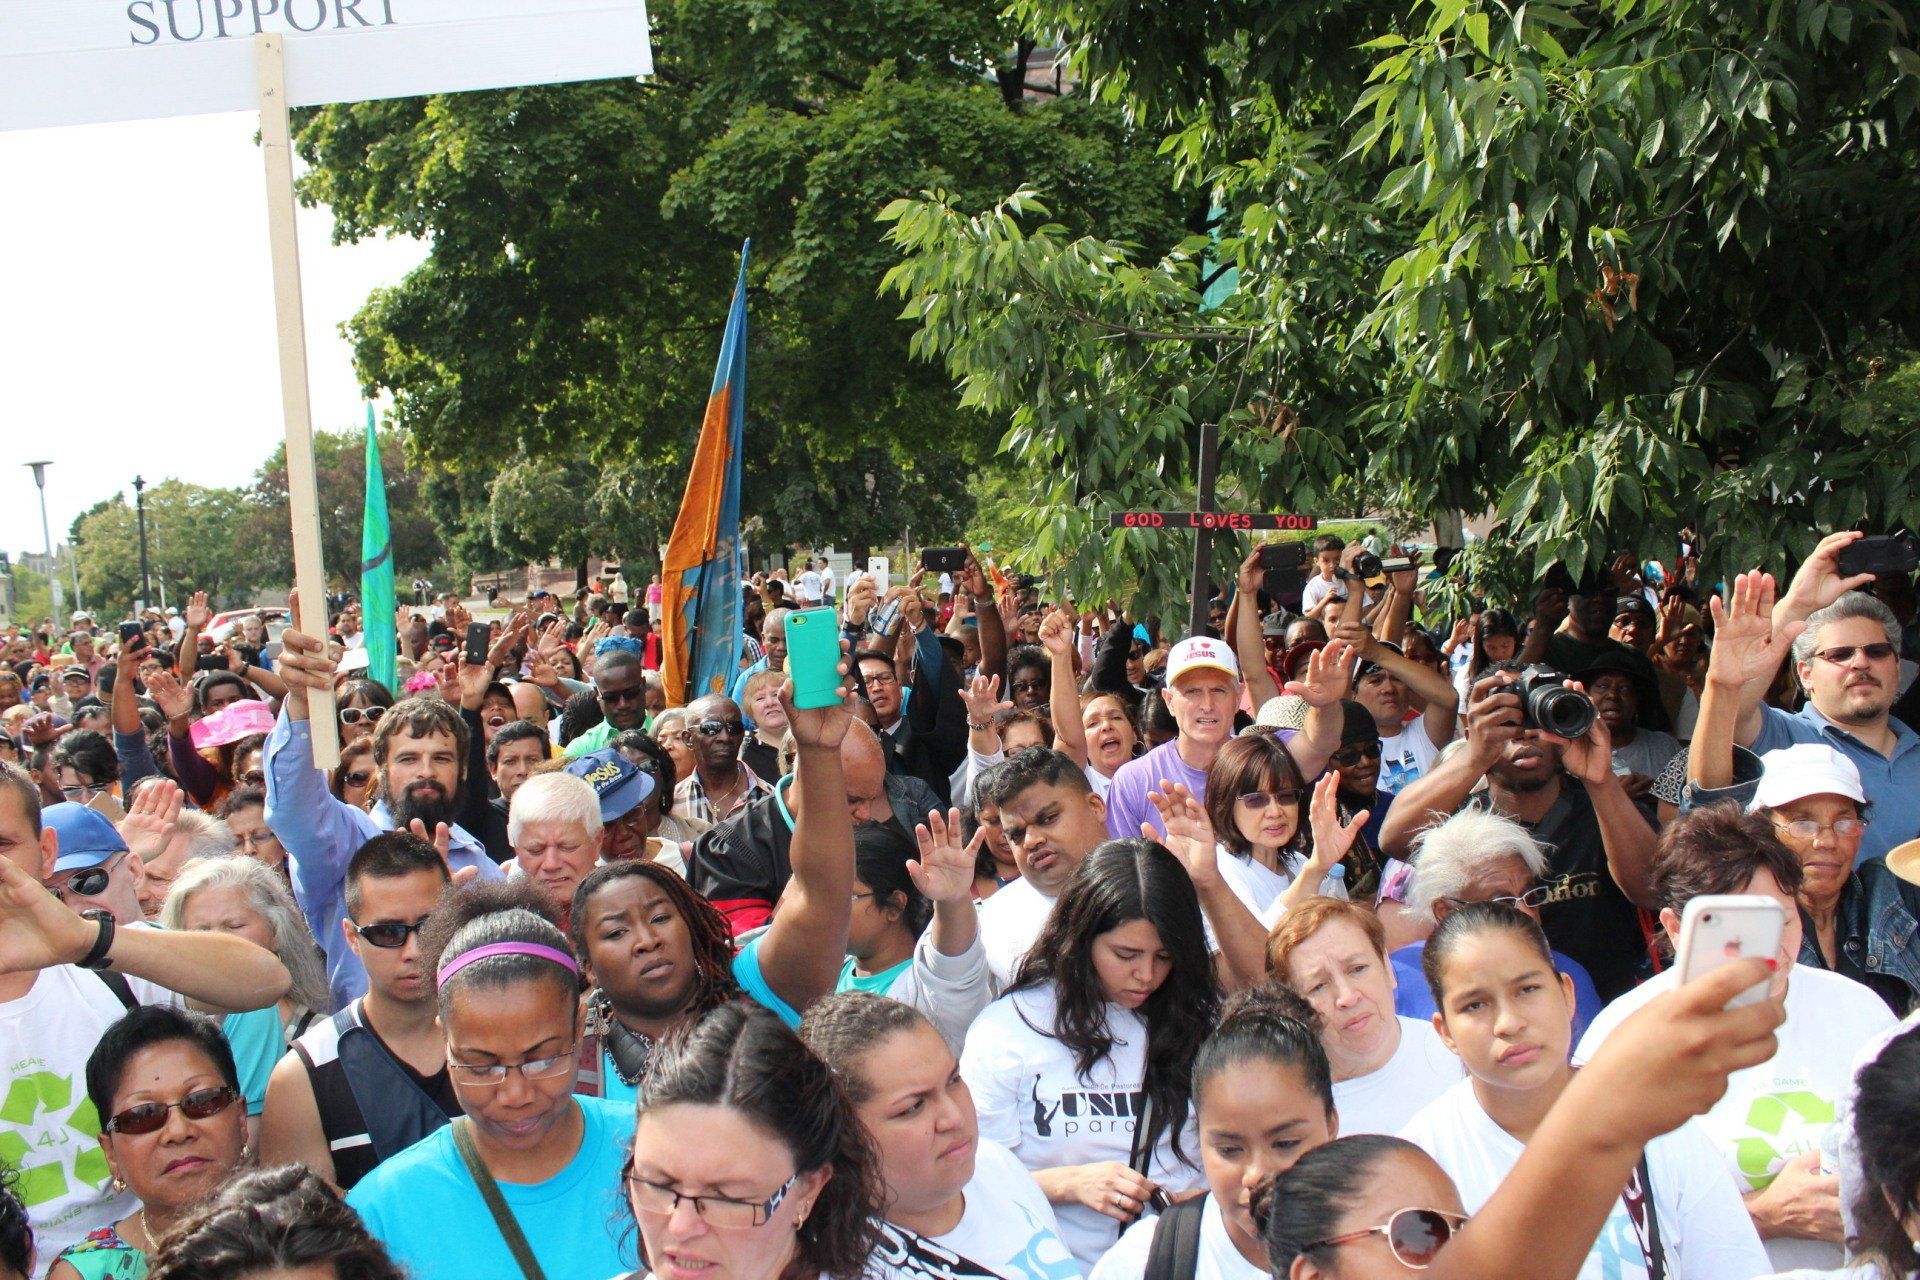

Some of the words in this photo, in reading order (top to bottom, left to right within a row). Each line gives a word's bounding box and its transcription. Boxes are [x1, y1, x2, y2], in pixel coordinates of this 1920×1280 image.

[1124, 513, 1164, 527] GOD
[1190, 512, 1252, 528] LOVES
[1275, 515, 1312, 530] YOU
[1186, 650, 1216, 661] JESUS
[1065, 1120, 1136, 1137] para
